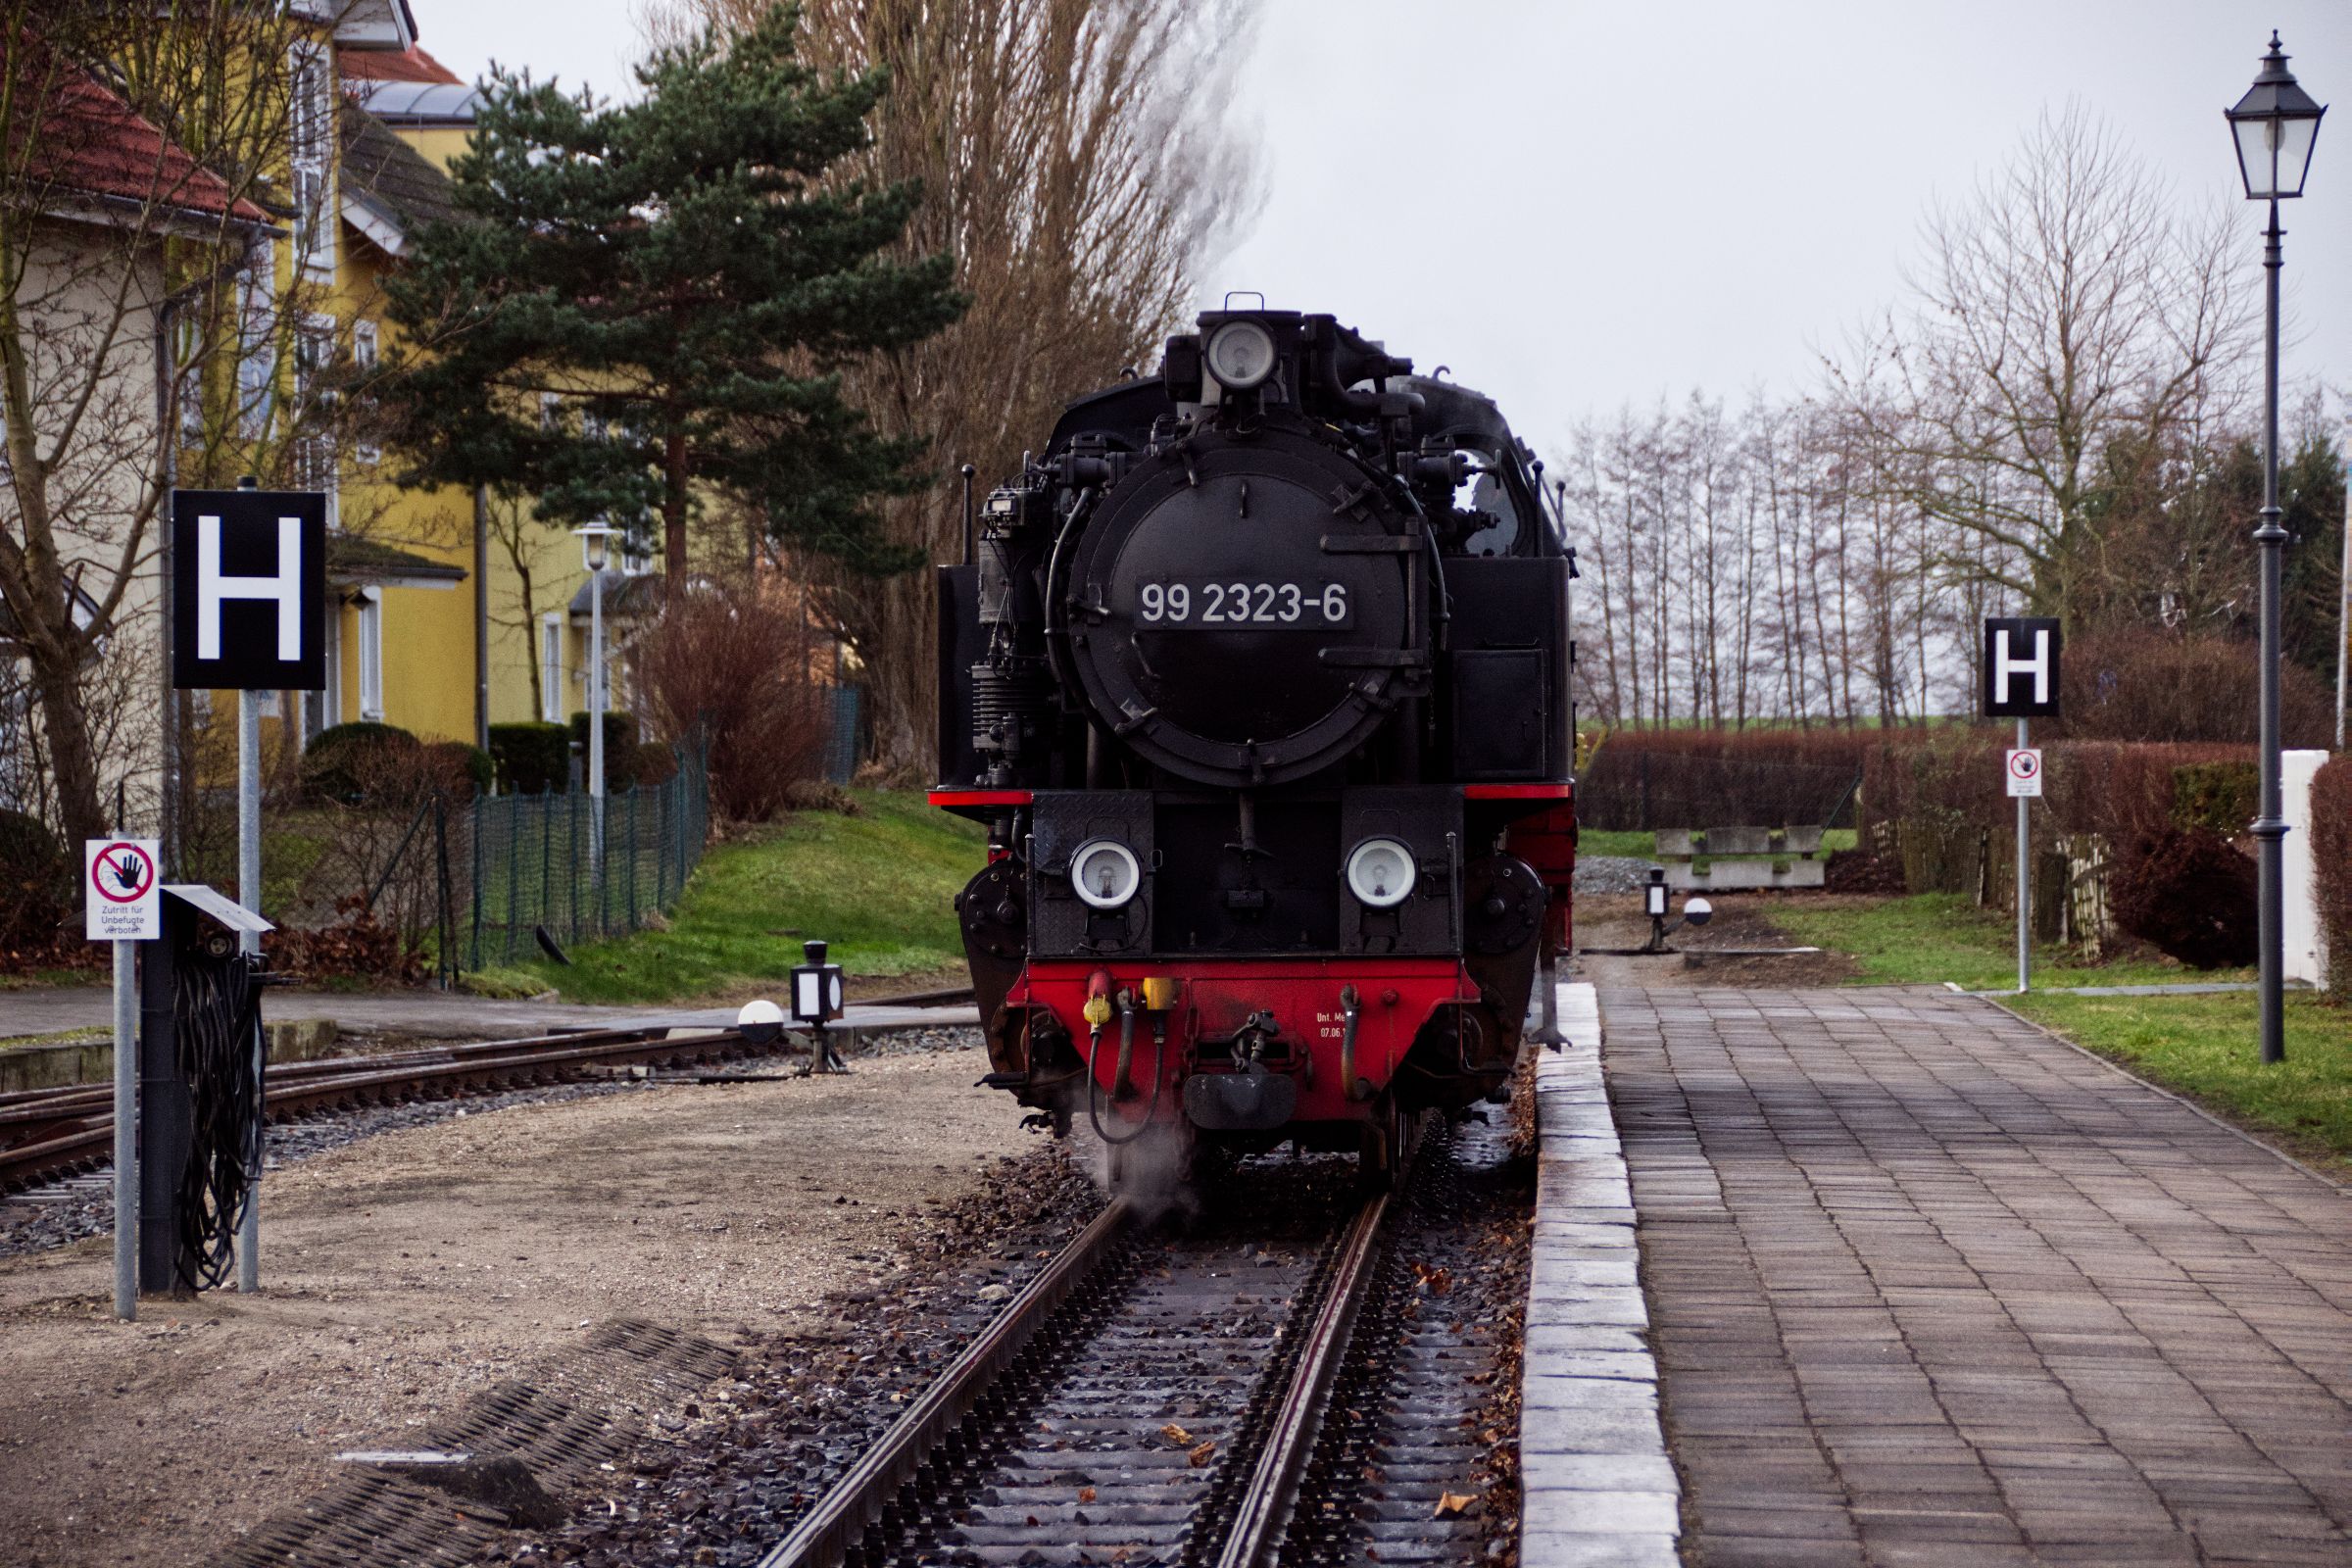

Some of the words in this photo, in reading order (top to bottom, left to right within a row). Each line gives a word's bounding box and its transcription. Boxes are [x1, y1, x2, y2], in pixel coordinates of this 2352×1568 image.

[198, 515, 301, 661] H
[1142, 583, 1190, 621] 99
[1202, 583, 1347, 621] 2323-6
[1995, 629, 2049, 704] H
[101, 916, 145, 926] Unbefugte
[102, 906, 128, 914] Zutritt
[131, 906, 144, 914] für
